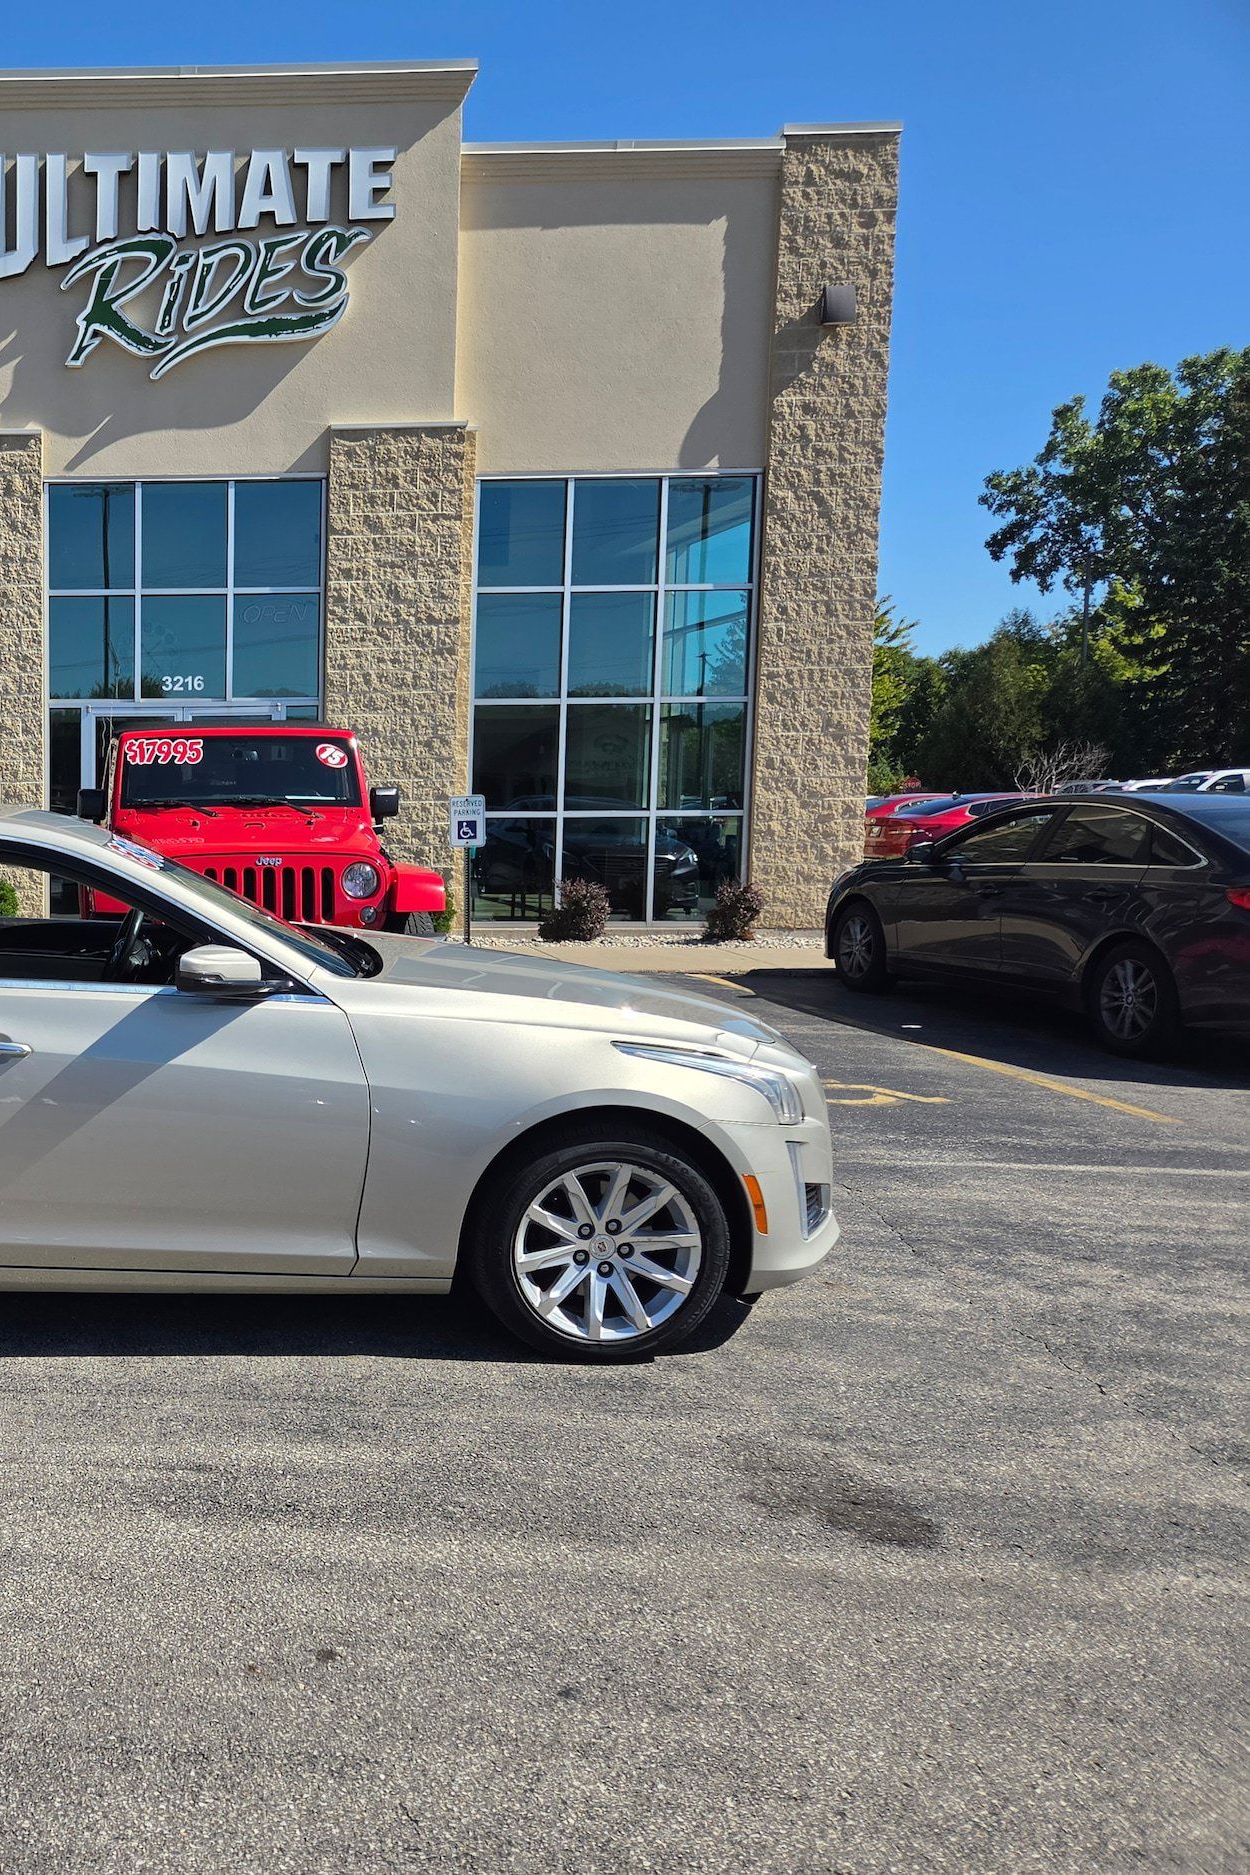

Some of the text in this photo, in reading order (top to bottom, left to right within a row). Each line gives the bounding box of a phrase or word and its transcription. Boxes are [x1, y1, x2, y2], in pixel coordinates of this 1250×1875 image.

[242, 604, 308, 623] OPEN
[161, 675, 205, 691] 3216
[125, 739, 203, 765] $17995
[451, 800, 483, 808] RESERVED
[256, 856, 283, 866] Jeep
